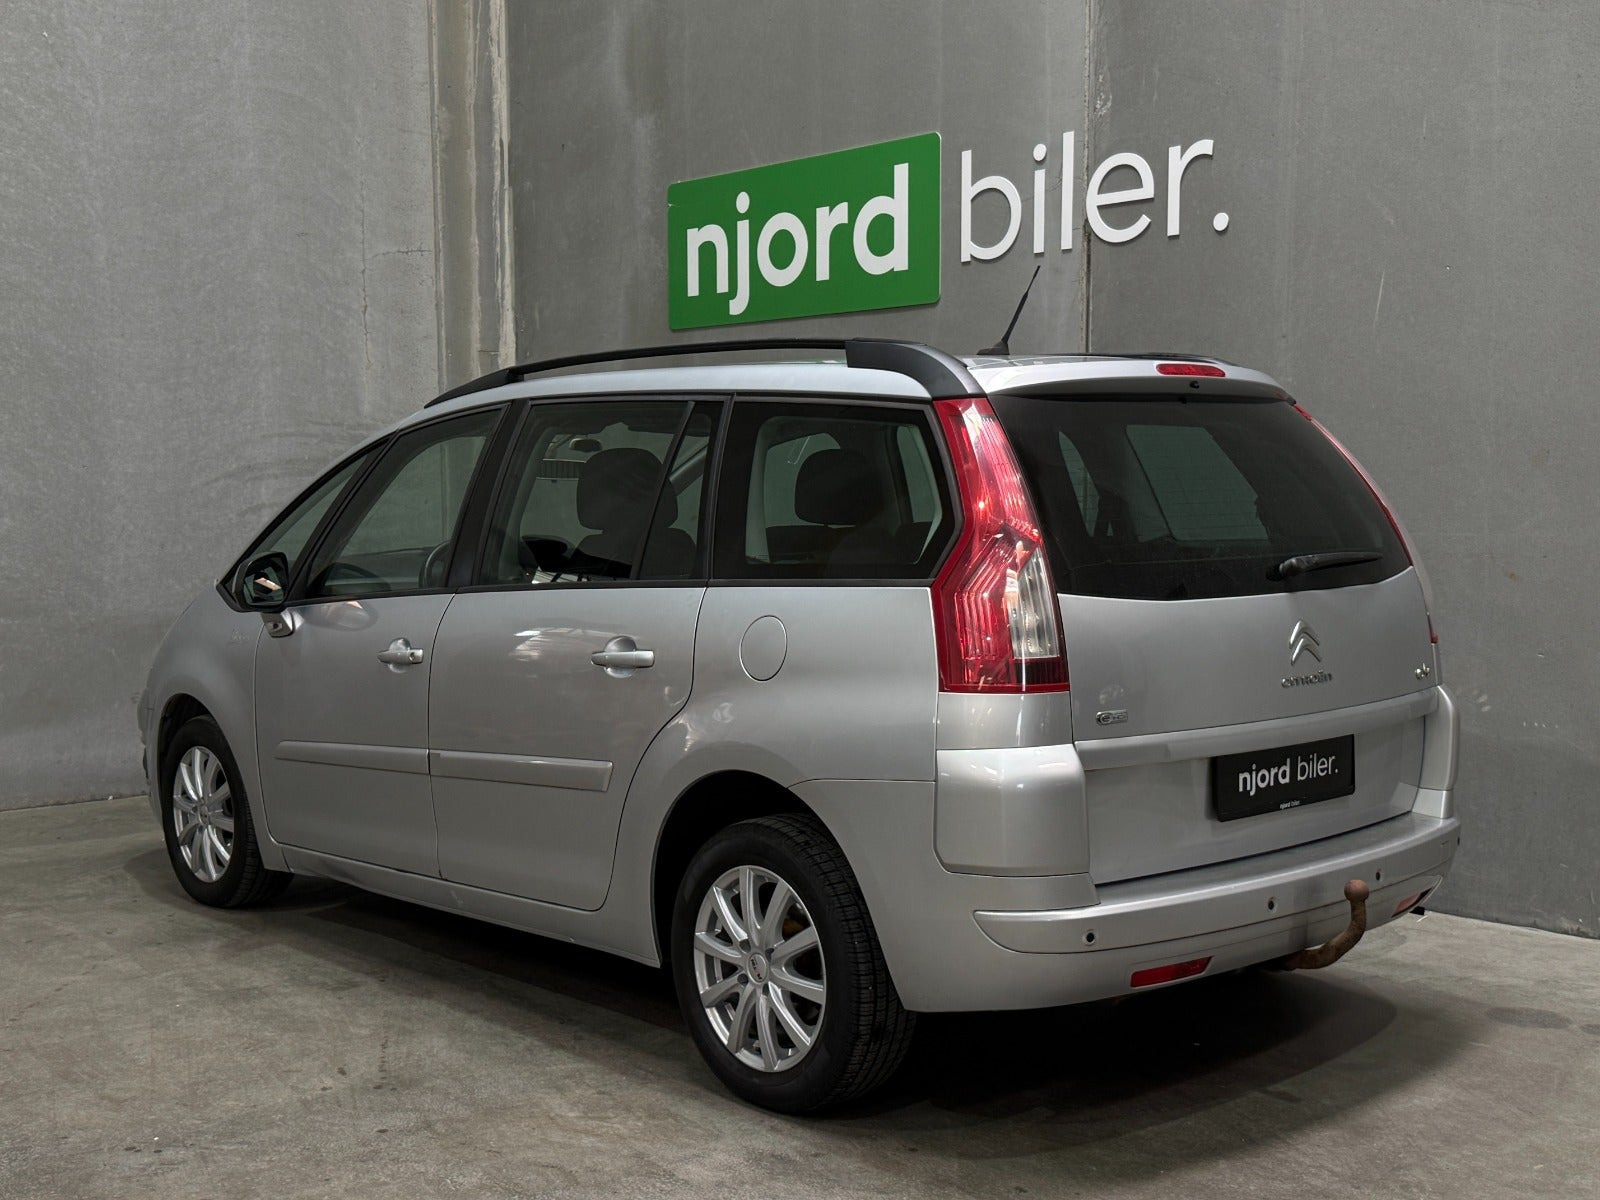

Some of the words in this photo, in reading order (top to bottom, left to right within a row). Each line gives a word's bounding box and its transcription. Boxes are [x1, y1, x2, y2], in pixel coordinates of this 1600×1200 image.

[686, 162, 909, 316] njord
[959, 129, 1231, 264] biler.
[1238, 757, 1290, 797] njord
[1297, 752, 1339, 781] biler.
